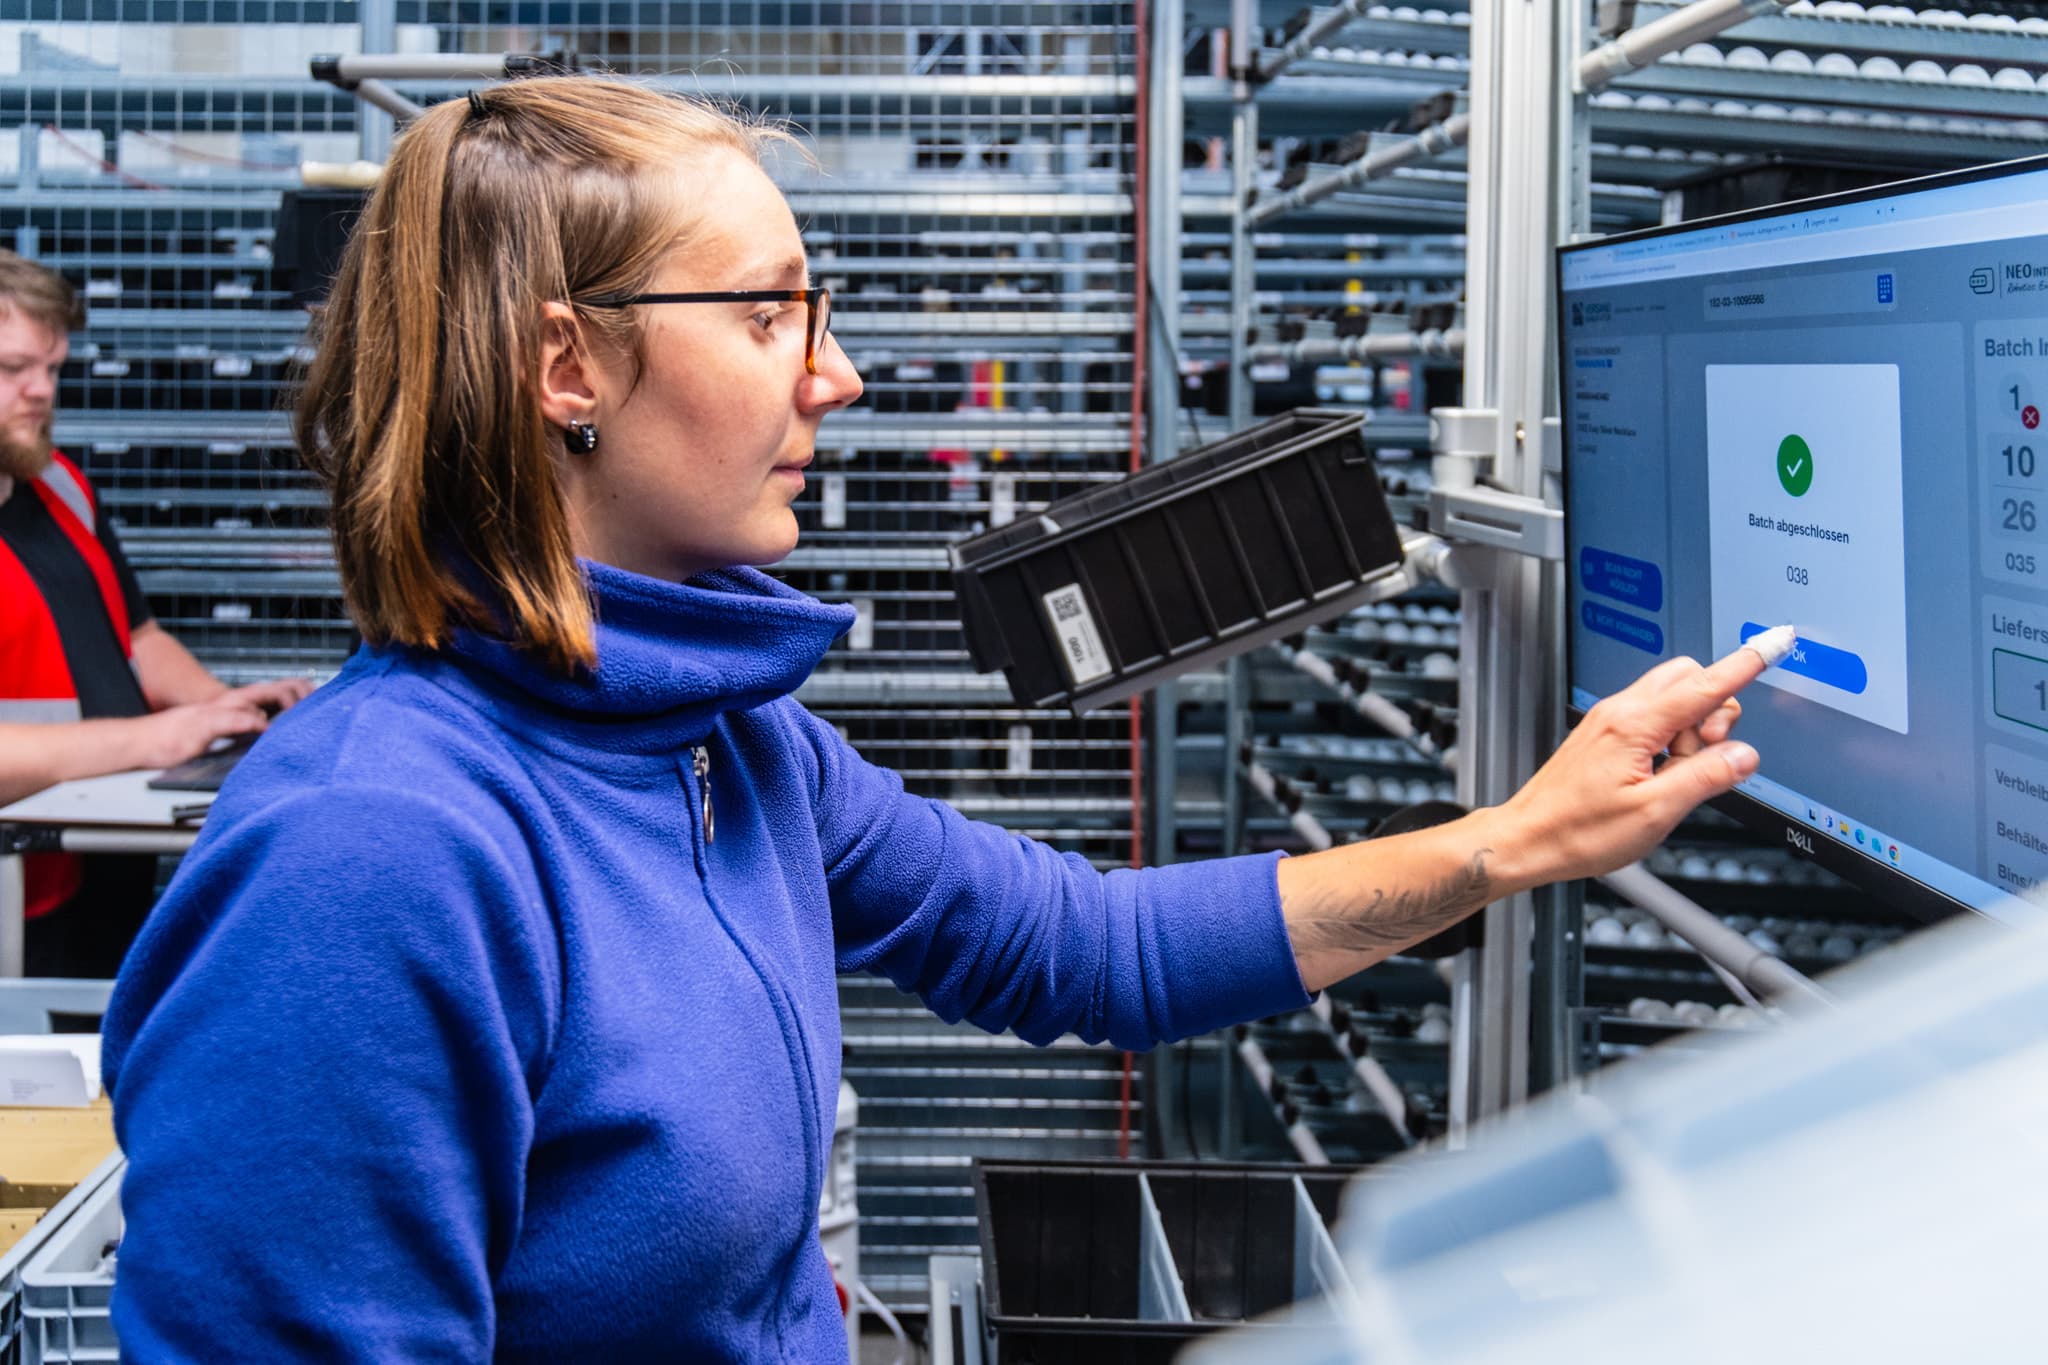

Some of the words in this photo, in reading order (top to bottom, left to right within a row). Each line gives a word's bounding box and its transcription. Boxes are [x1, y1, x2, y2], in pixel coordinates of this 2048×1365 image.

[1984, 338, 2033, 357] Batch
[2009, 384, 2020, 411] 1
[2002, 445, 2035, 477] 10
[1749, 513, 1774, 530] Batch
[1776, 519, 1850, 544] abgeschlossen
[2003, 498, 2037, 532] 26
[1786, 565, 1809, 586] 038
[2005, 552, 2036, 574] 035
[1992, 613, 2048, 645] Liefers
[1792, 648, 1807, 665] OK
[1786, 826, 1815, 855] DELL
